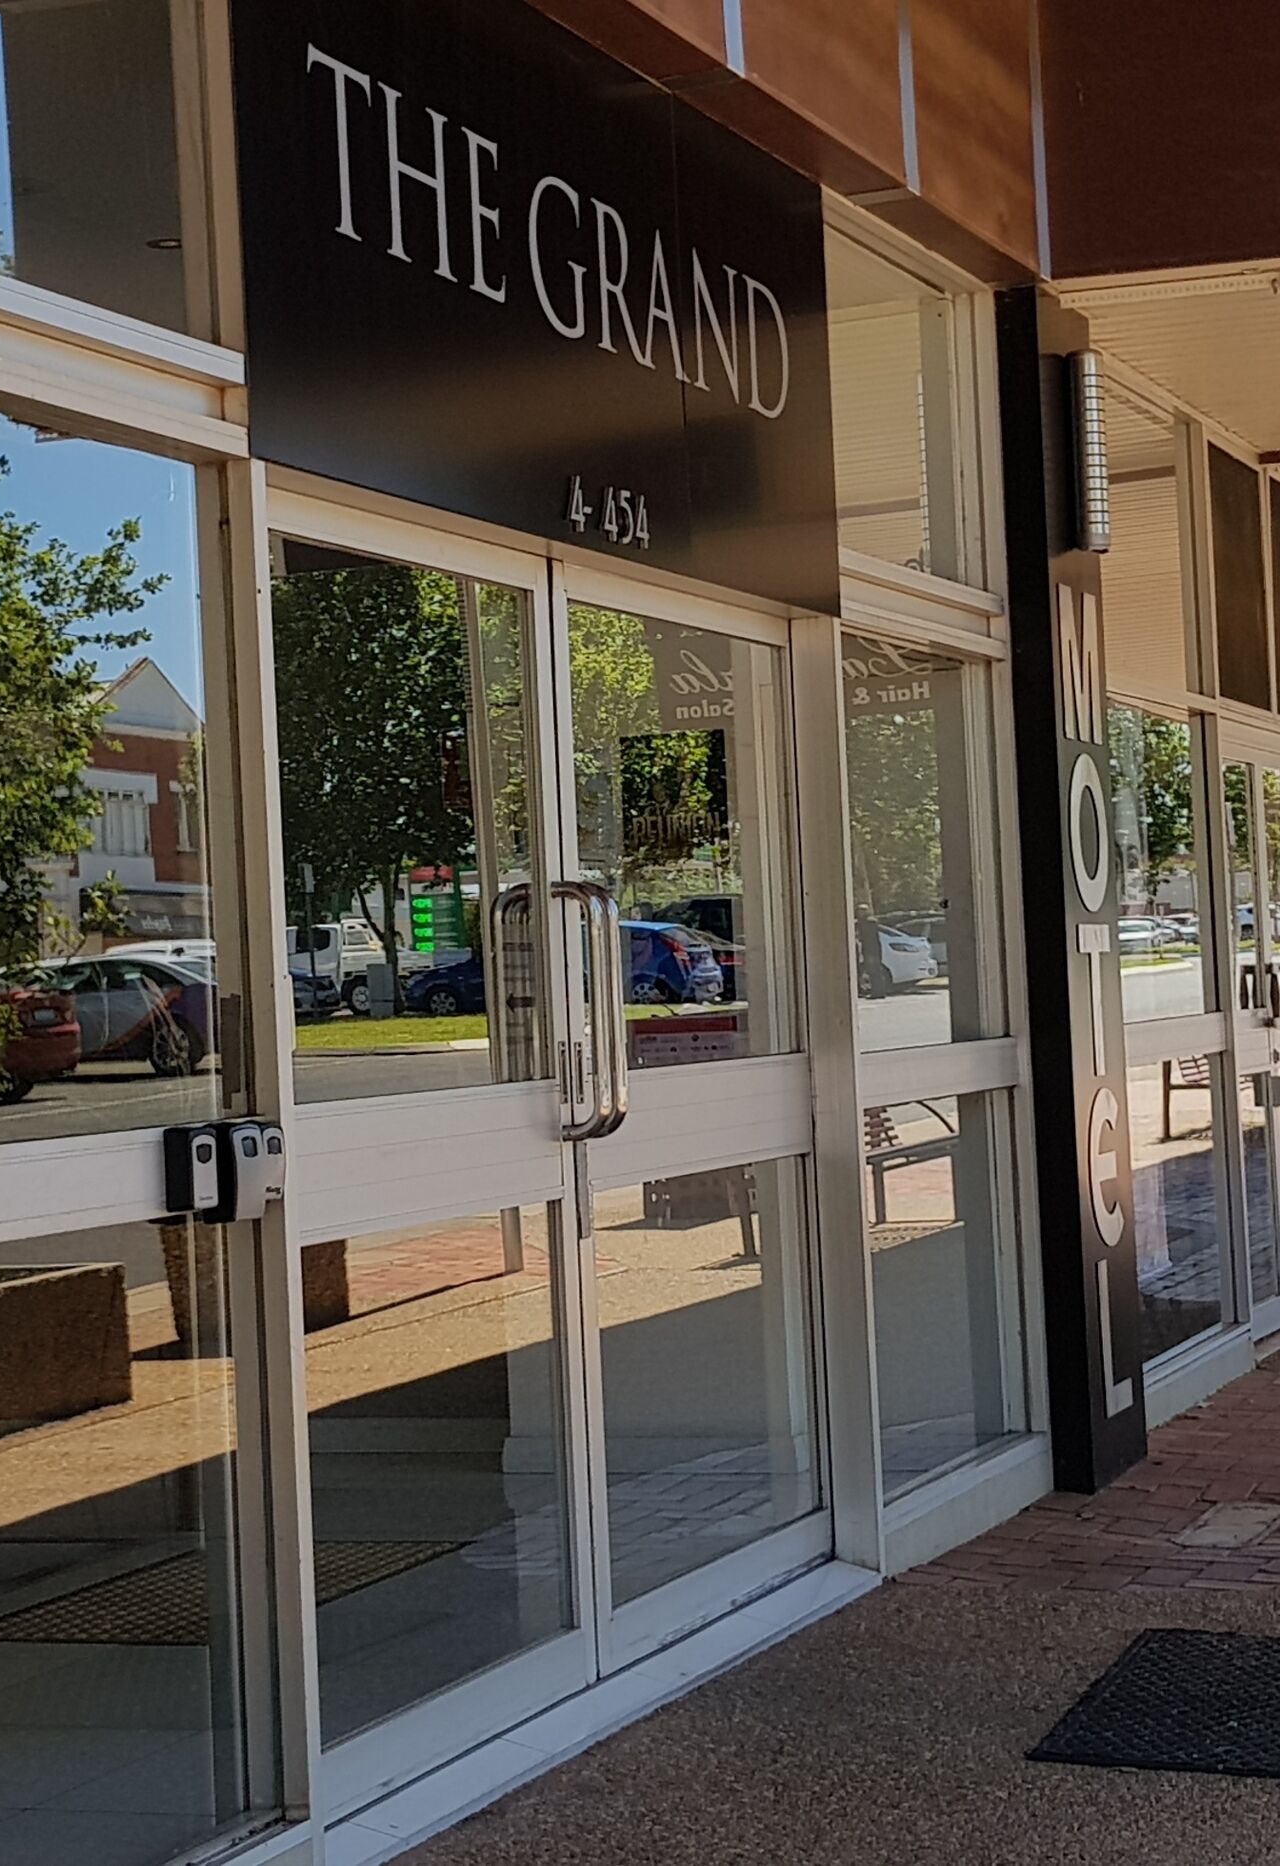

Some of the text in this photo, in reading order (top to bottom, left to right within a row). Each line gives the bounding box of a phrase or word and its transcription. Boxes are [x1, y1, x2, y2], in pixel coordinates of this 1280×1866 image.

[306, 42, 790, 420] THE GRAND
[604, 486, 650, 550] 454
